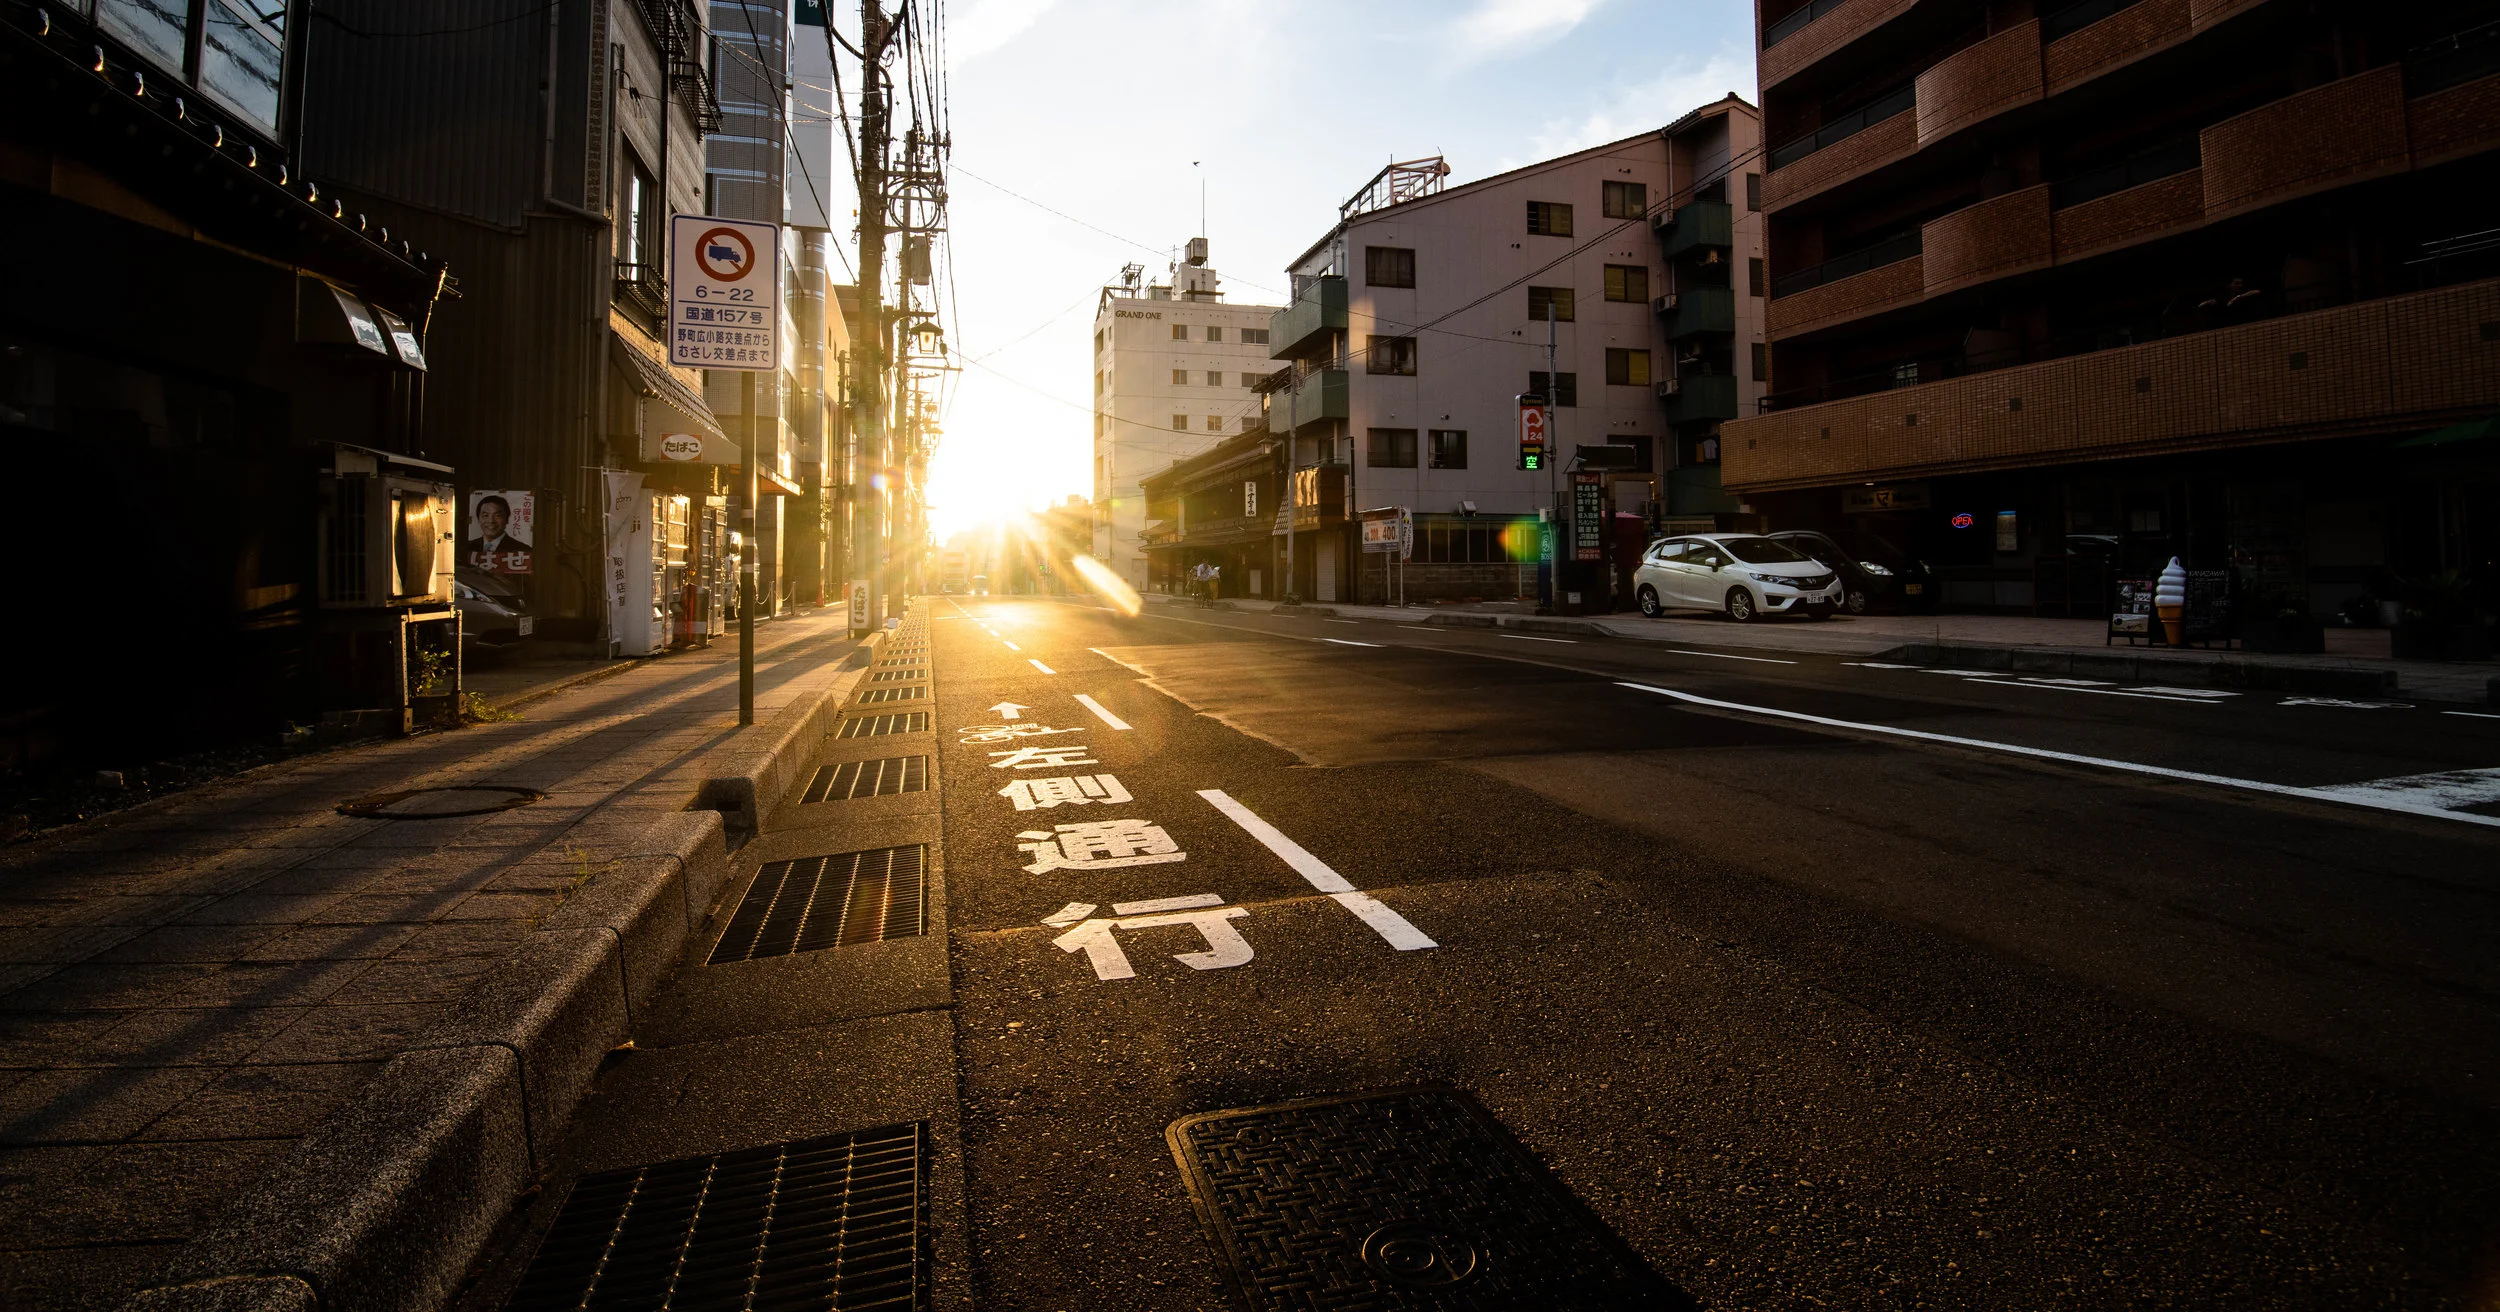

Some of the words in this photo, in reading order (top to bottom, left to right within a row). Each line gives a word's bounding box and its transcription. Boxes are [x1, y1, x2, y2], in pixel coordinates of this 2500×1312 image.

[686, 306, 763, 325] 国道157号
[1115, 310, 1144, 319] GRAND
[1145, 311, 1162, 320] ONE
[677, 328, 770, 347] 野町広小路交差点から
[678, 345, 770, 363] むさし交差点まで
[664, 441, 699, 453] たばこ
[1526, 455, 1538, 469] 空
[512, 508, 522, 537] 守りたい
[1383, 526, 1396, 540] 400
[470, 551, 531, 572] はせ
[853, 586, 866, 624] たばこ
[988, 746, 1255, 981] 左側通行
